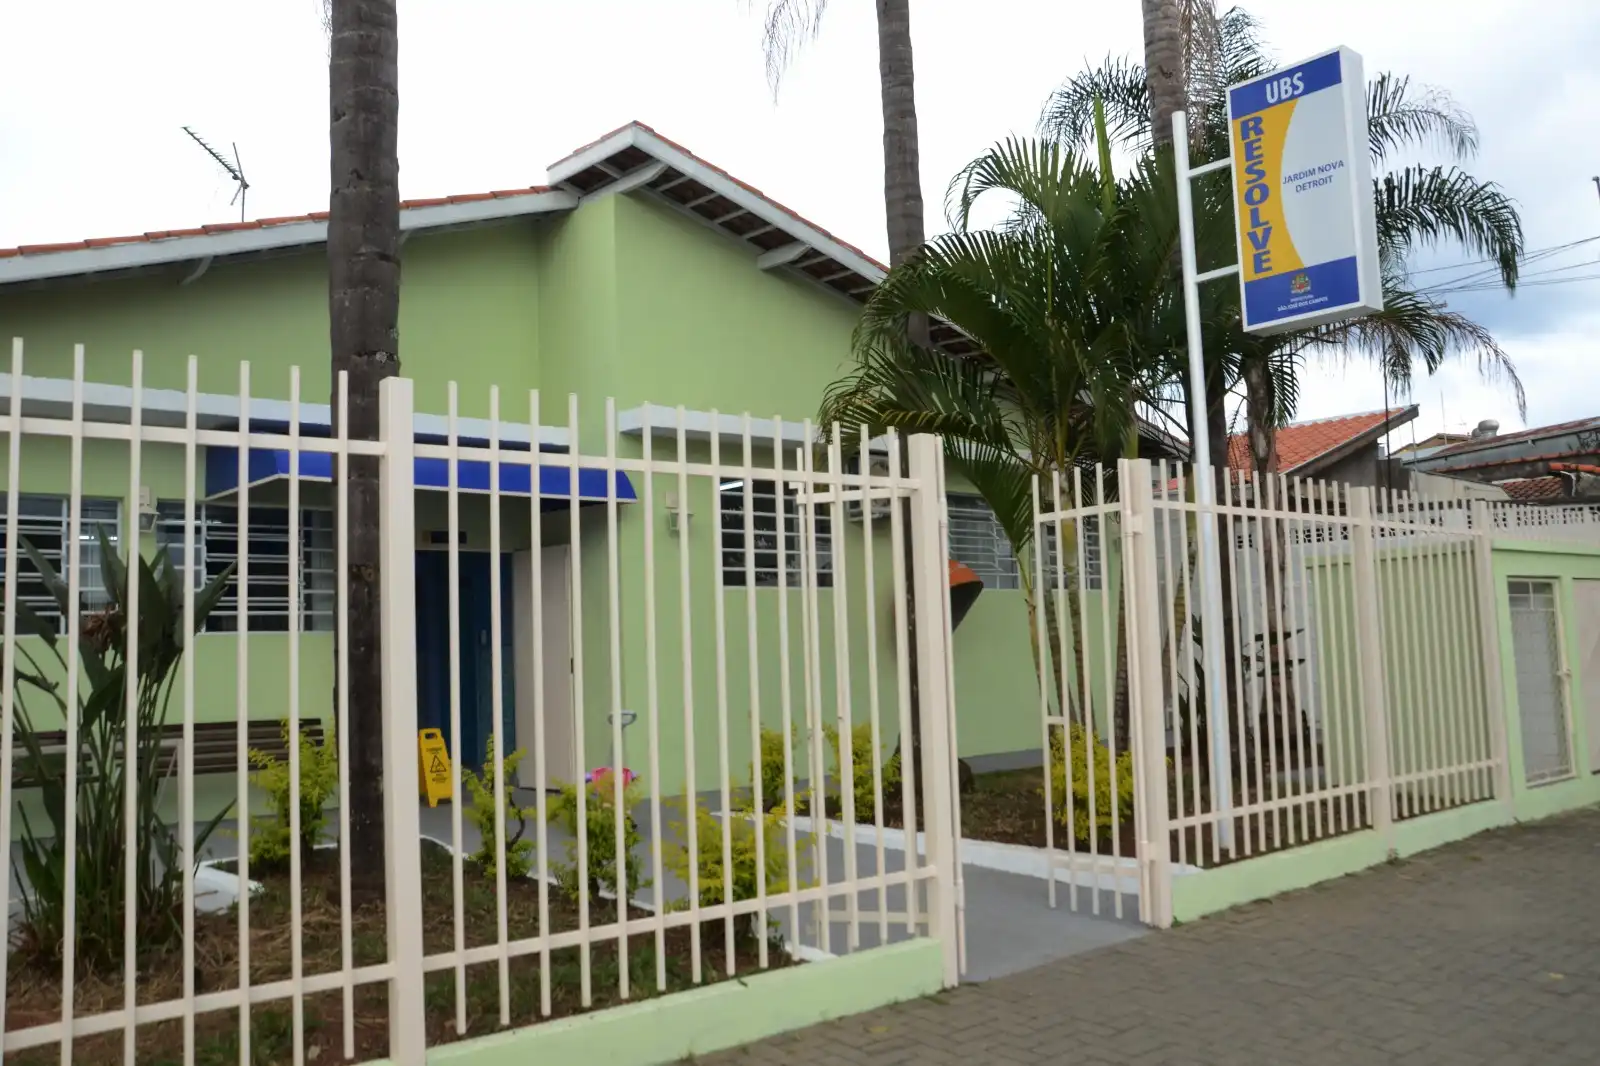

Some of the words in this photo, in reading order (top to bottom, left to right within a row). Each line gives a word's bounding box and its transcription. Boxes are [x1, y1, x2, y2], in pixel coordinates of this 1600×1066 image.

[1265, 71, 1304, 104] UBS
[1282, 167, 1317, 184] JARDIM
[1317, 159, 1345, 175] NOVA
[1295, 175, 1333, 193] DETROIT
[1240, 116, 1273, 274] RESOLVE
